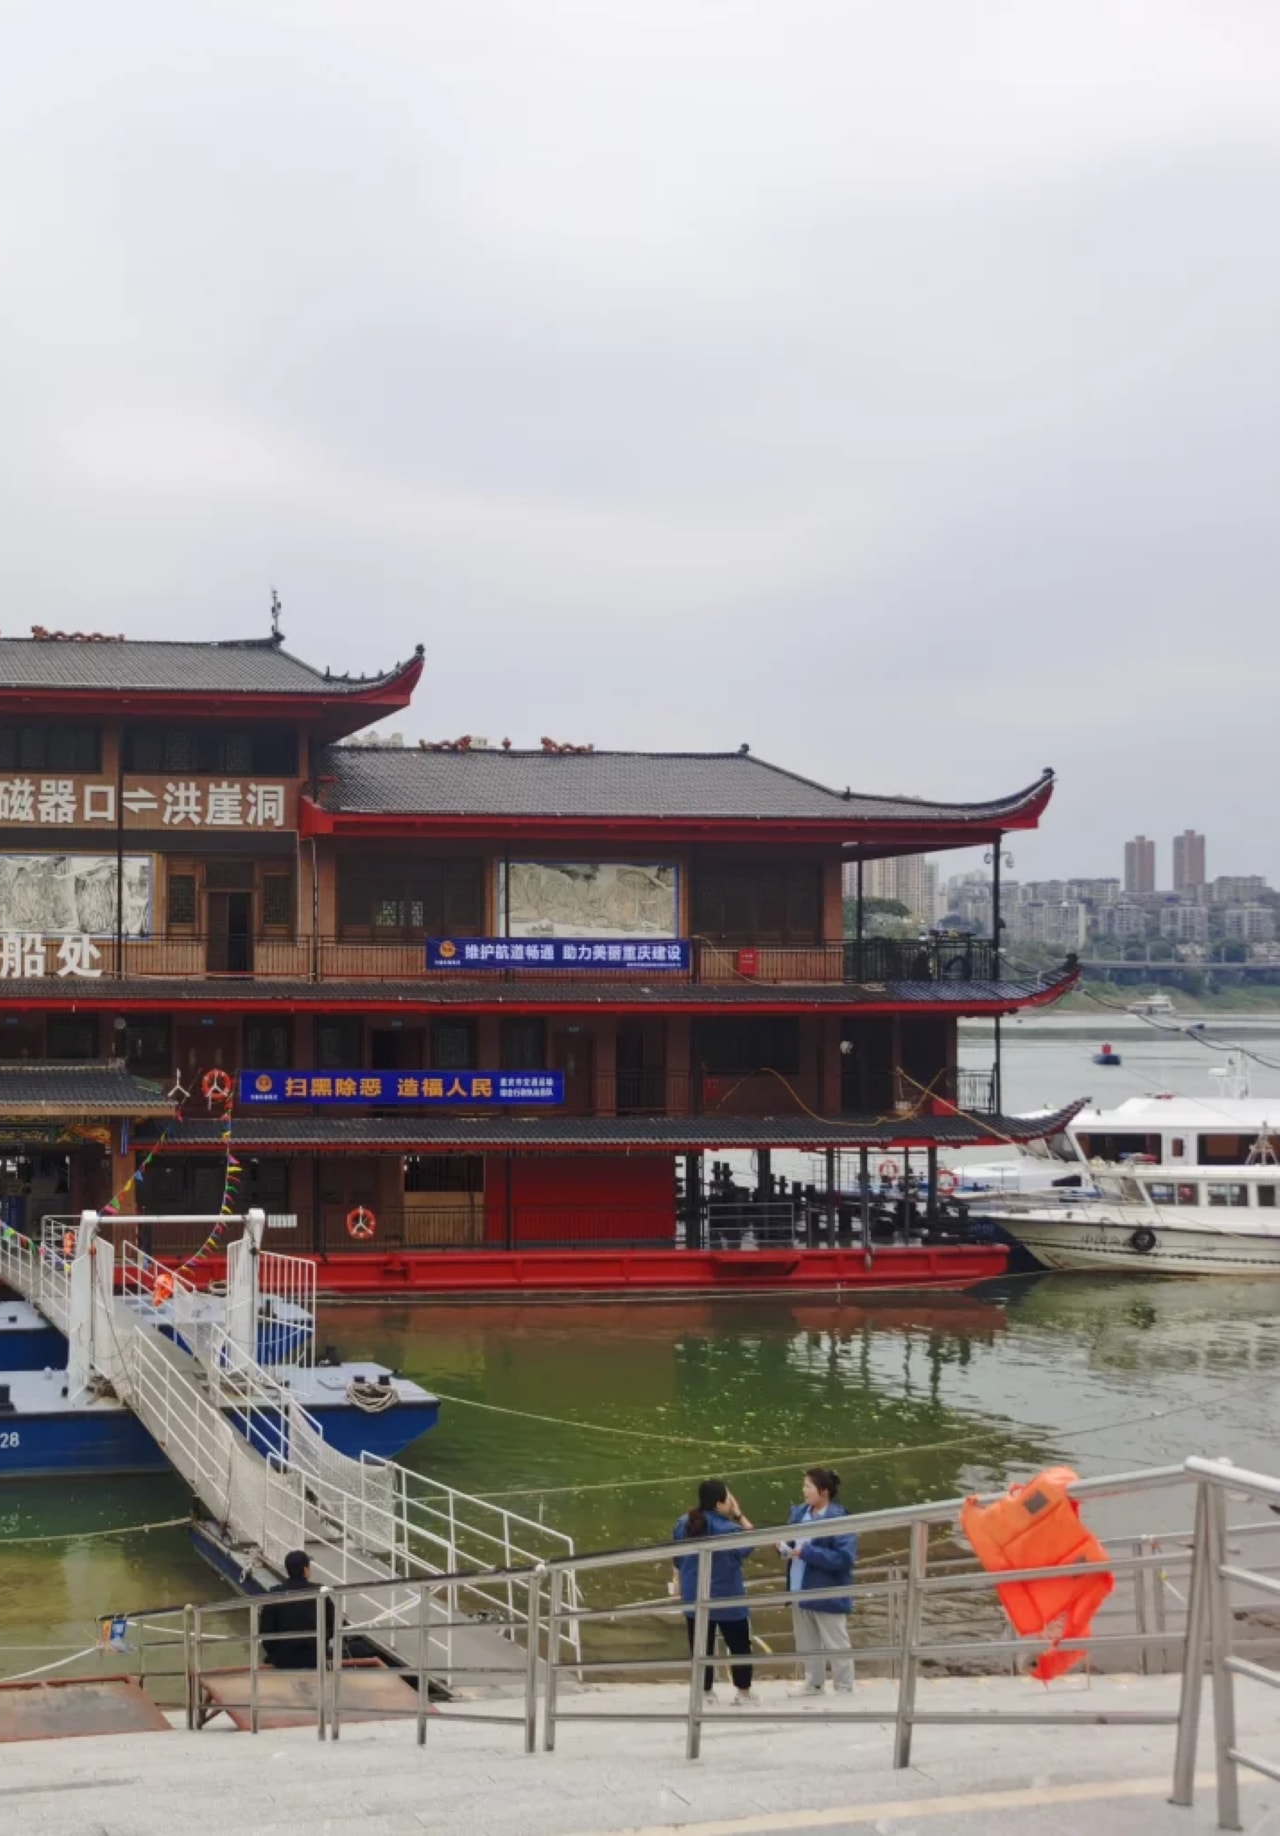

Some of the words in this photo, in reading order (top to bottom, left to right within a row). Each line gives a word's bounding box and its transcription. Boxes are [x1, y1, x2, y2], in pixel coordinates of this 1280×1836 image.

[161, 781, 287, 828] 洪崖洞
[464, 943, 555, 961] 维护航道畅通
[562, 943, 682, 962] 助力美丽重庆建设
[284, 1077, 383, 1099] 扫黑除恶
[396, 1077, 494, 1099] 造福人民
